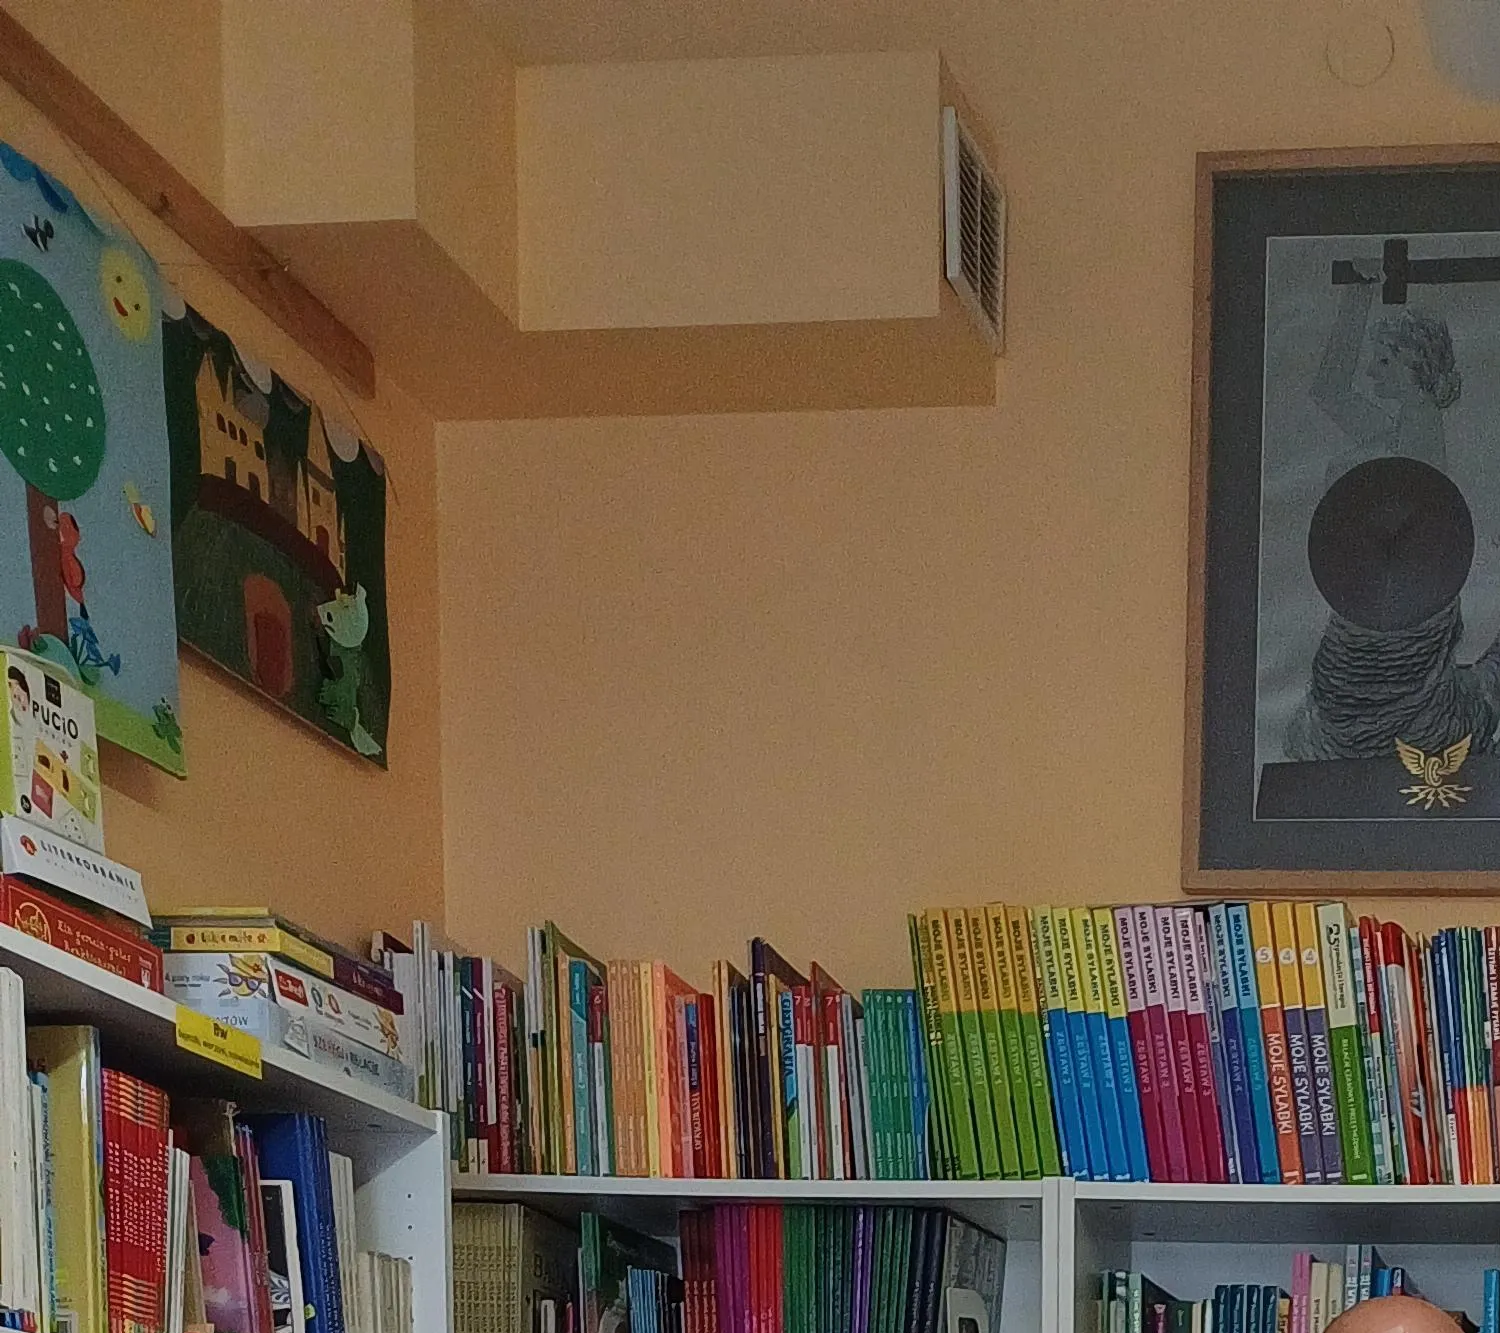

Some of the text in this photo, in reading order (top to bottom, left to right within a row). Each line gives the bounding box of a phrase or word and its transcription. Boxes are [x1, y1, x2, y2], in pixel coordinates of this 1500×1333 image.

[1119, 918, 1131, 948] MOJE
[1161, 917, 1172, 948] MOJE
[1180, 920, 1191, 951] MOJE
[1267, 1033, 1292, 1135] MOJE SYLABKI
[1290, 1034, 1315, 1136] MOJE SYLABKI
[1311, 1034, 1335, 1136] MOJE SYLABKI
